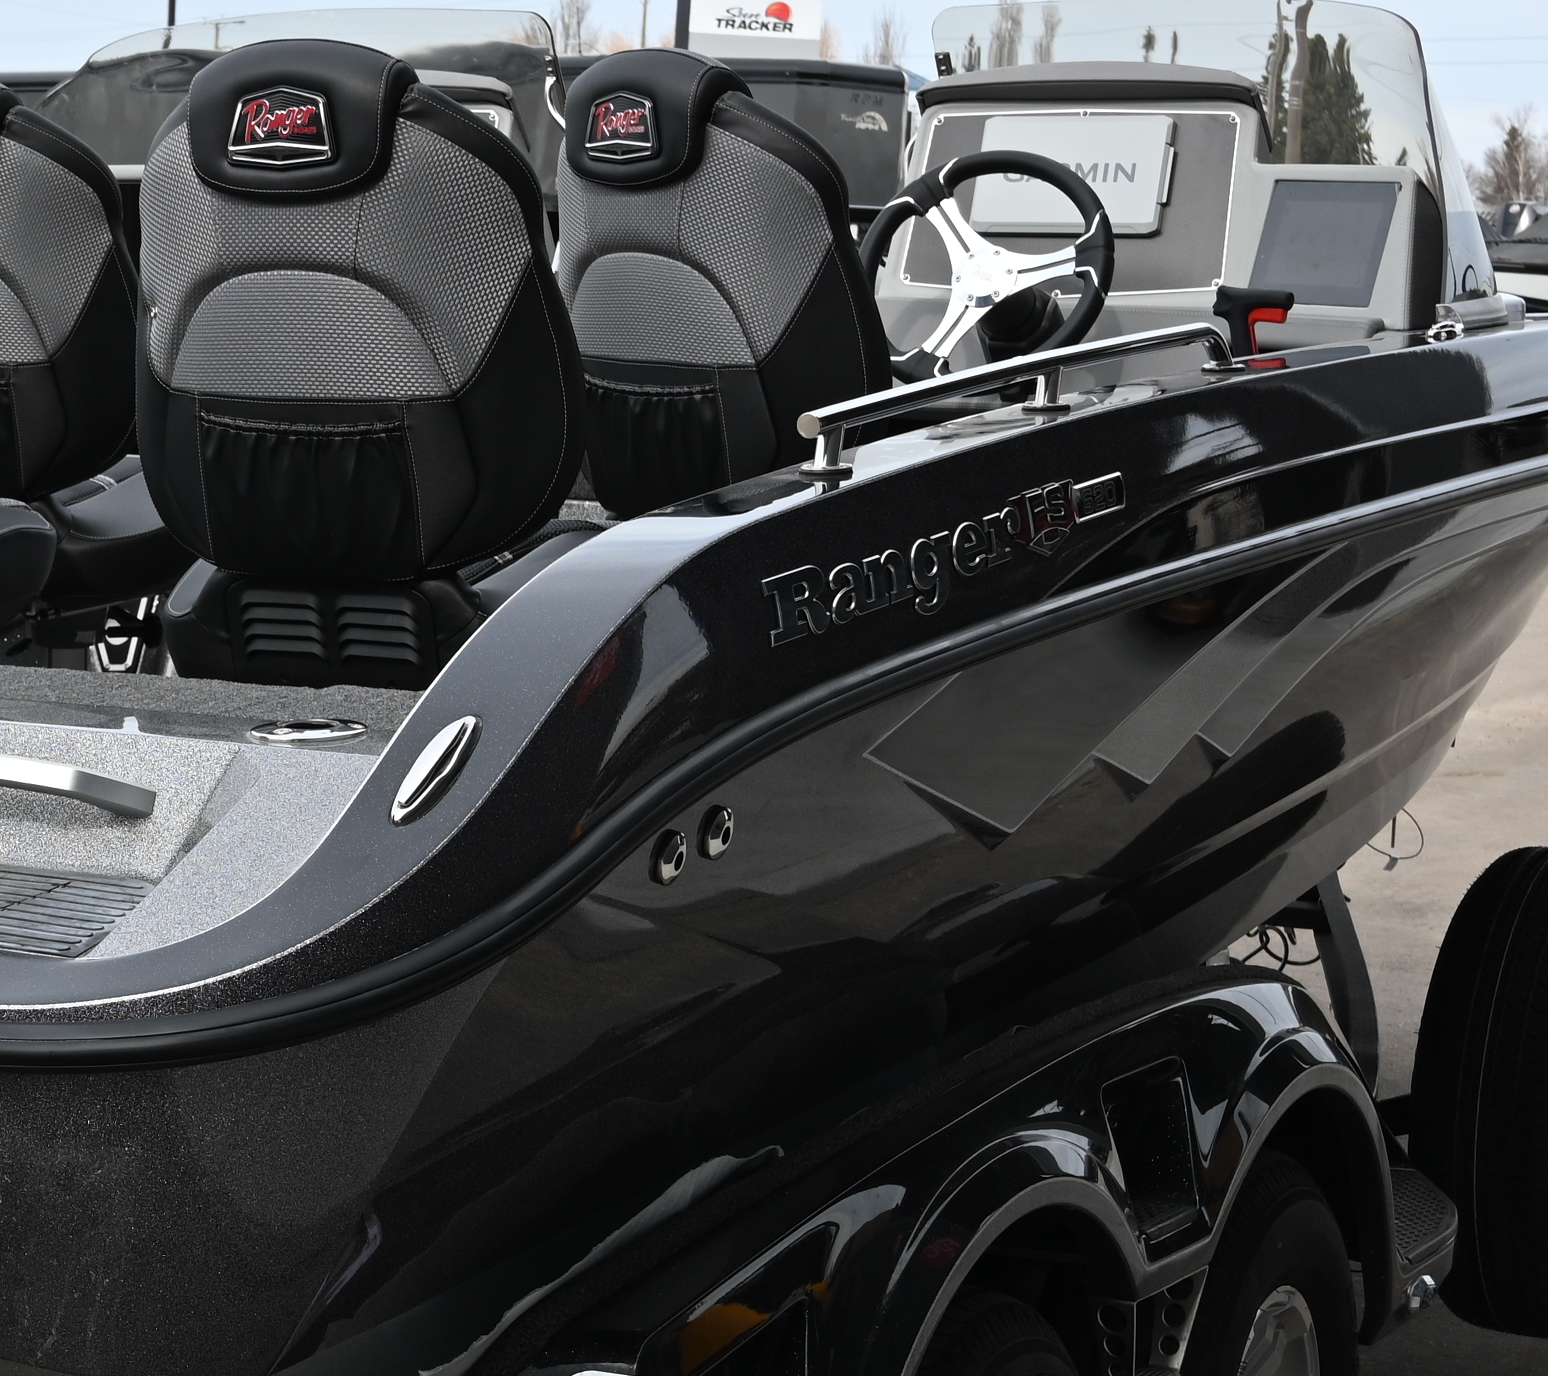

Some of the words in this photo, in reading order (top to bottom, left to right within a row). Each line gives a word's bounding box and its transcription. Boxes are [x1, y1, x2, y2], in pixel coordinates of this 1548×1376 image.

[715, 18, 794, 33] TRACKER
[241, 99, 317, 144] Ranger
[595, 103, 646, 139] Ranger
[1002, 162, 1137, 183] GMIN
[760, 505, 1022, 648] Ranger
[1081, 482, 1117, 516] 620
